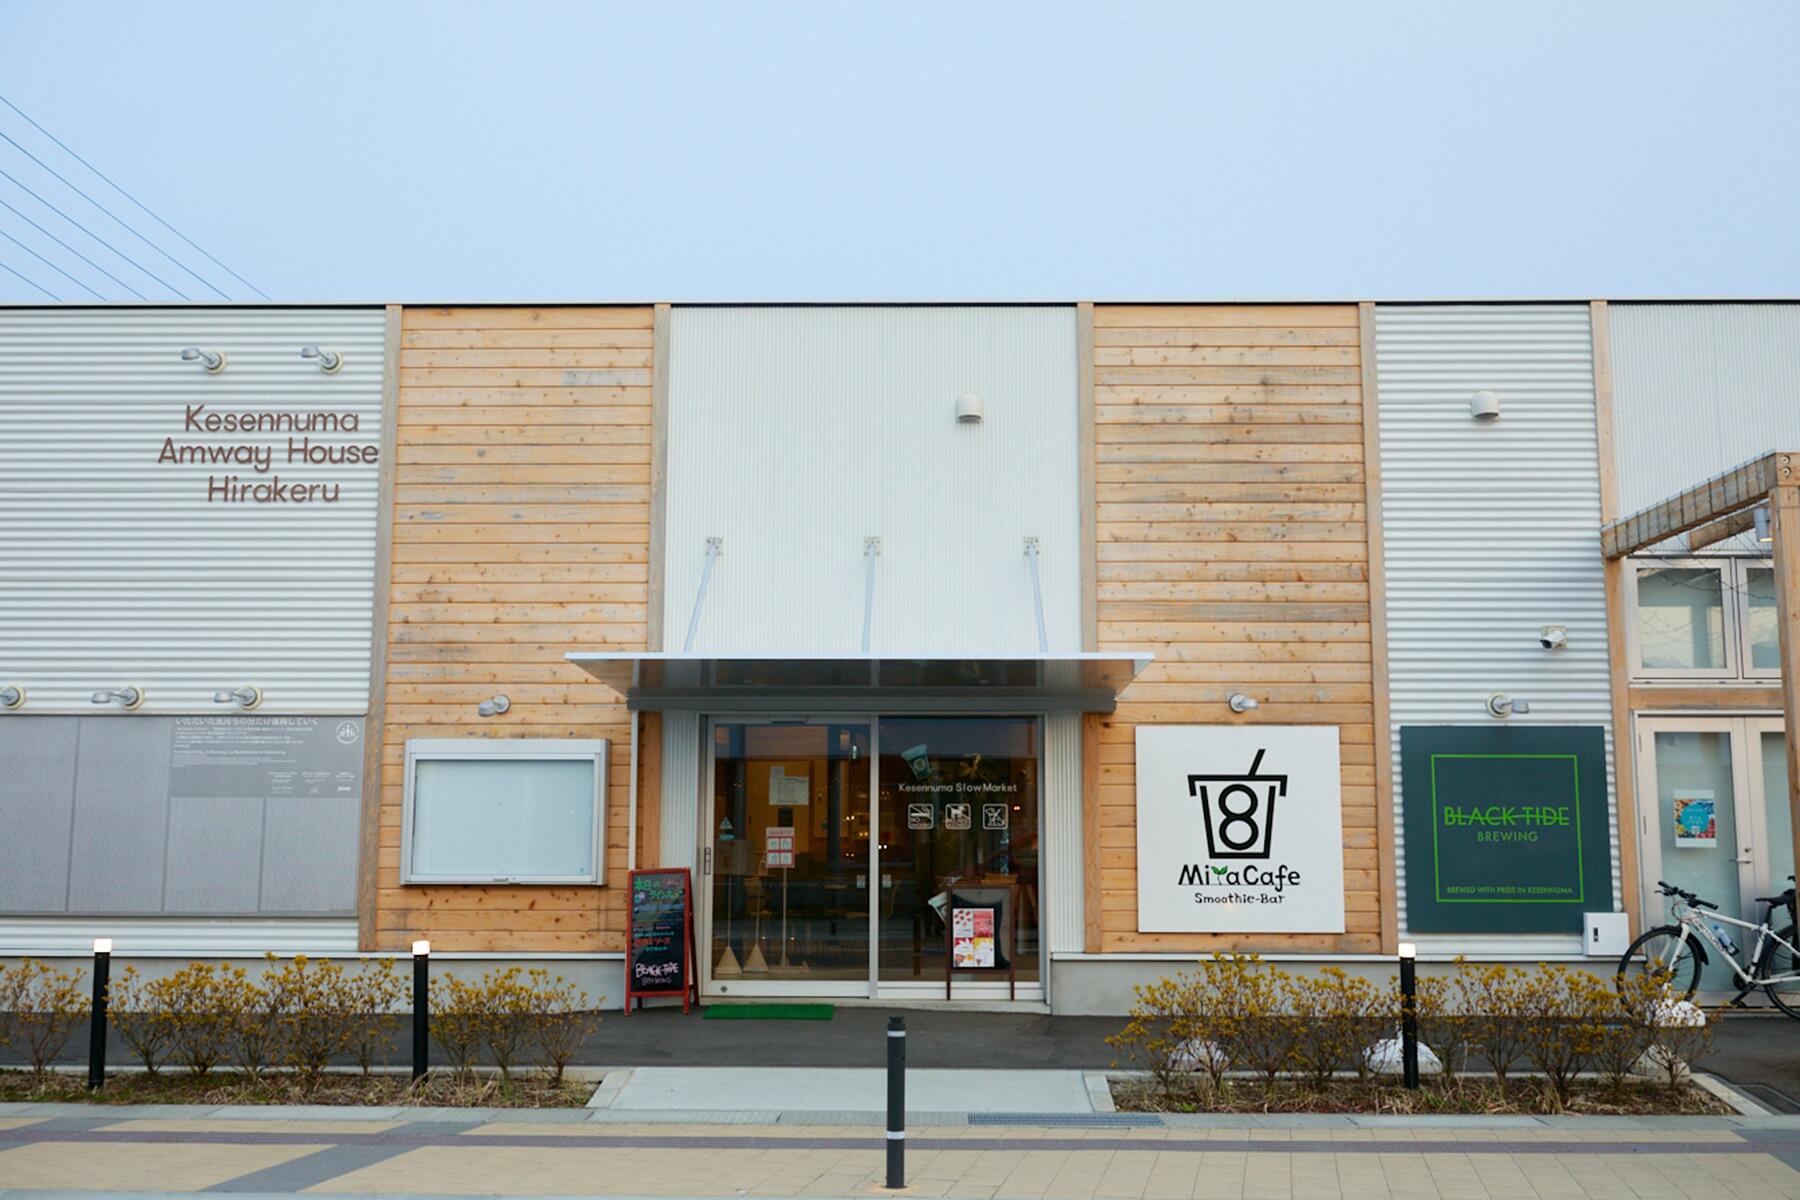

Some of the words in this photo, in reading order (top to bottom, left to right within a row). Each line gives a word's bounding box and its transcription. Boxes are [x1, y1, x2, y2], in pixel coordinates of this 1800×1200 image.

[185, 404, 359, 432] Kesennuma
[157, 437, 271, 473] Amway
[287, 436, 379, 464] House
[207, 475, 339, 503] Hirakeru
[898, 782, 953, 793] Kesennuma
[1444, 806, 1516, 826] BLACK
[1522, 806, 1570, 826] TIDE
[1477, 831, 1539, 842] BREWING
[1447, 886, 1476, 894] BREWED
[1477, 886, 1496, 894] WITH
